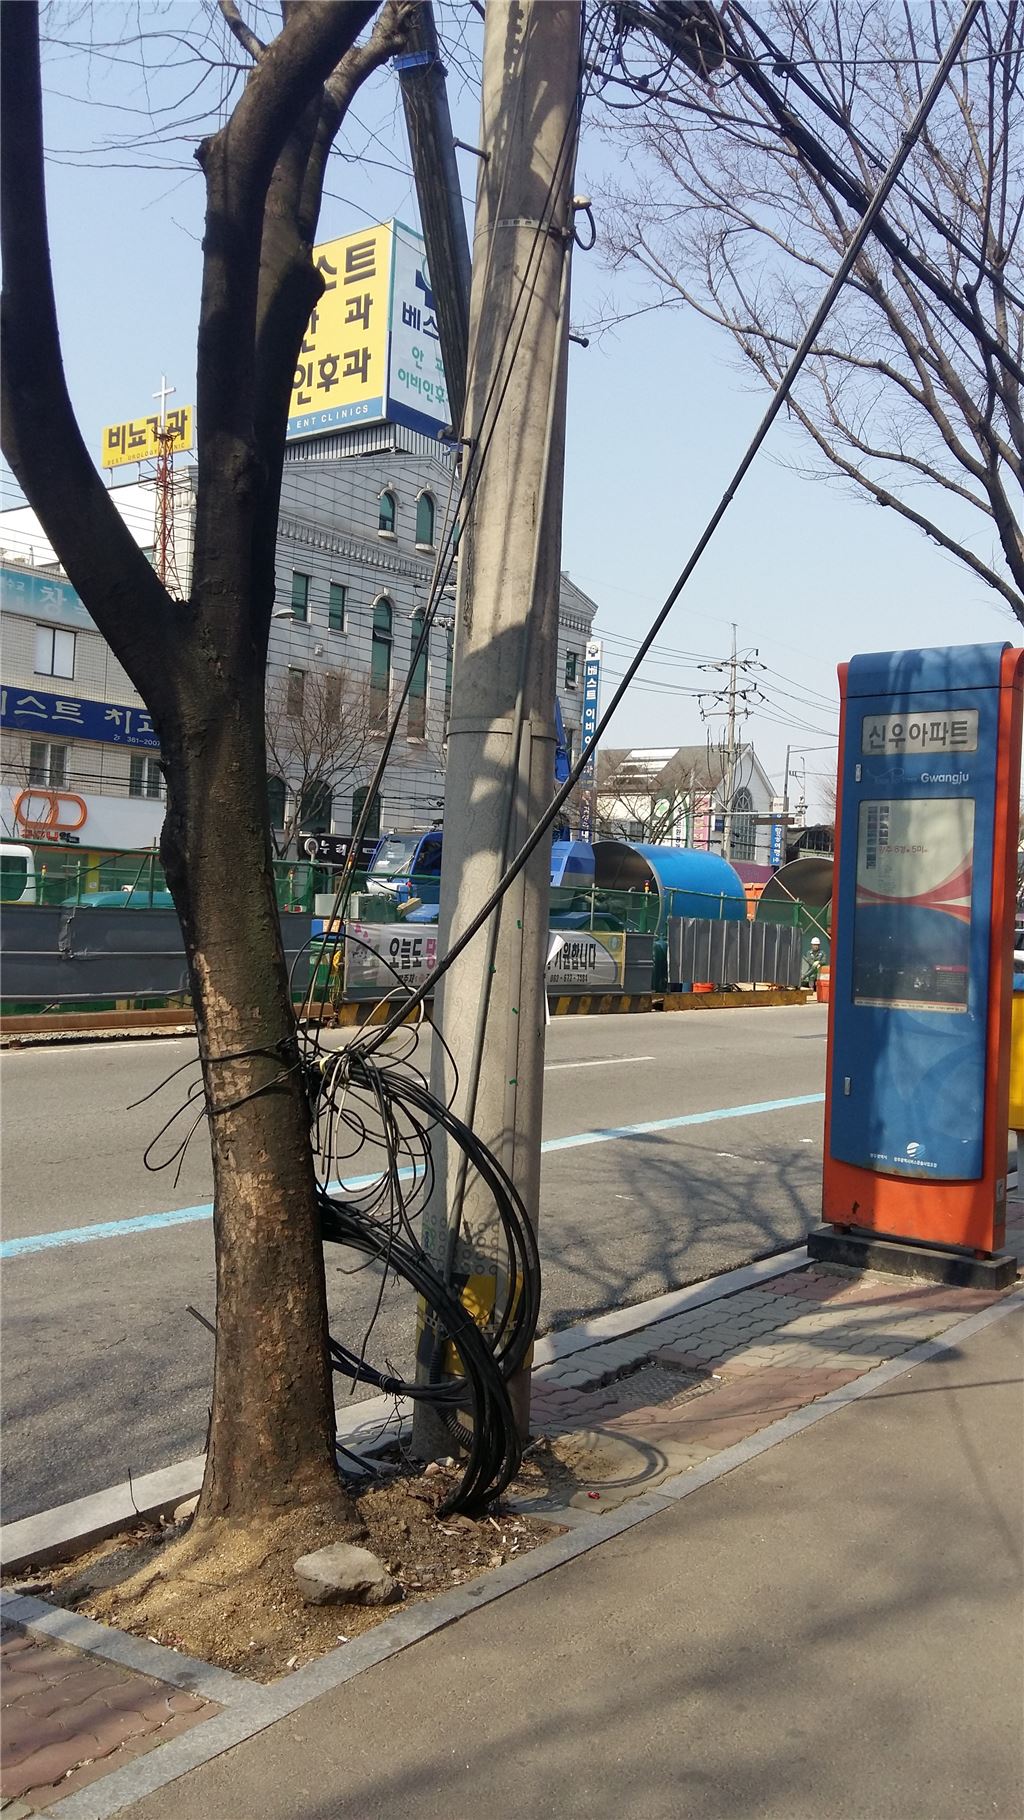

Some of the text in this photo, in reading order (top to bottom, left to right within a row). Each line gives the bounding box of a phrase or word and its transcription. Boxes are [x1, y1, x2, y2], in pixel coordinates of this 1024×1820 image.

[397, 369, 449, 404] 이비인후
[108, 409, 188, 455] 비뇨기과
[296, 404, 369, 429] ENT CLINICS
[586, 665, 598, 700] 베스트
[868, 720, 968, 750] 신우아파트
[920, 772, 969, 785] Gwangju
[389, 937, 423, 970] 오늘도
[553, 942, 597, 971] 기원합니다
